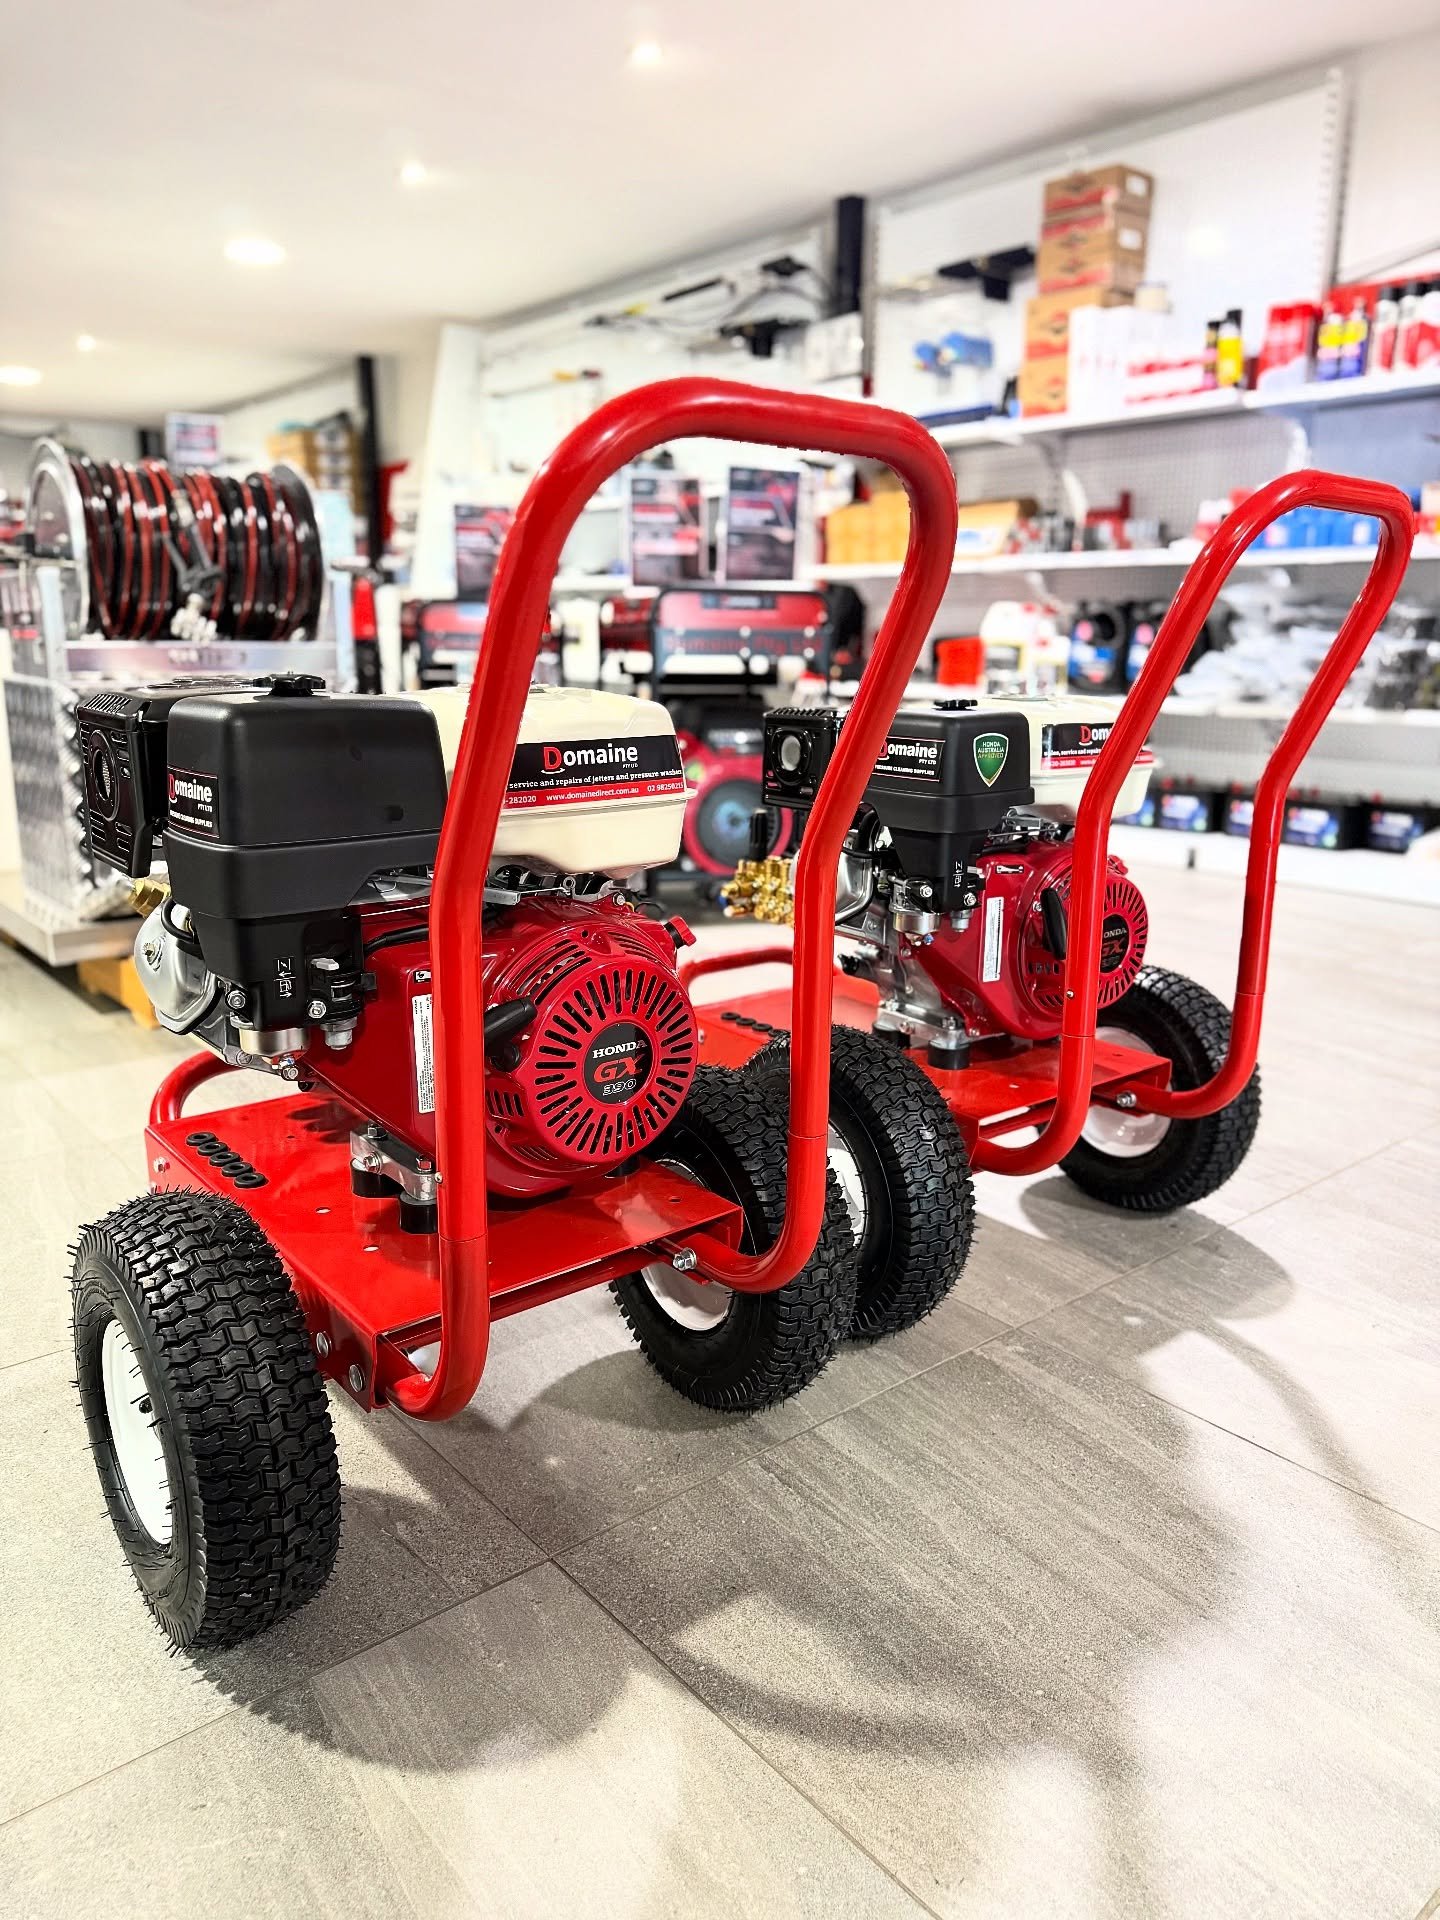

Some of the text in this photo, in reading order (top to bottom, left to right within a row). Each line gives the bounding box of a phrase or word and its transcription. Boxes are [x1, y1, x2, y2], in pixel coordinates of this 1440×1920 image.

[544, 743, 638, 770] Domaine
[169, 773, 213, 803] Domaine
[509, 781, 539, 789] service
[539, 779, 555, 787] and
[555, 777, 583, 787] repairs
[591, 774, 615, 785] jetters
[615, 773, 630, 781] and
[629, 770, 660, 781] pressure
[546, 787, 640, 802] www.domainedirect.com.au
[647, 784, 656, 793] 02
[1103, 927, 1128, 939] ONDA
[592, 1039, 648, 1059] HONDA
[593, 1053, 645, 1084] GX
[602, 1078, 637, 1097] 390
